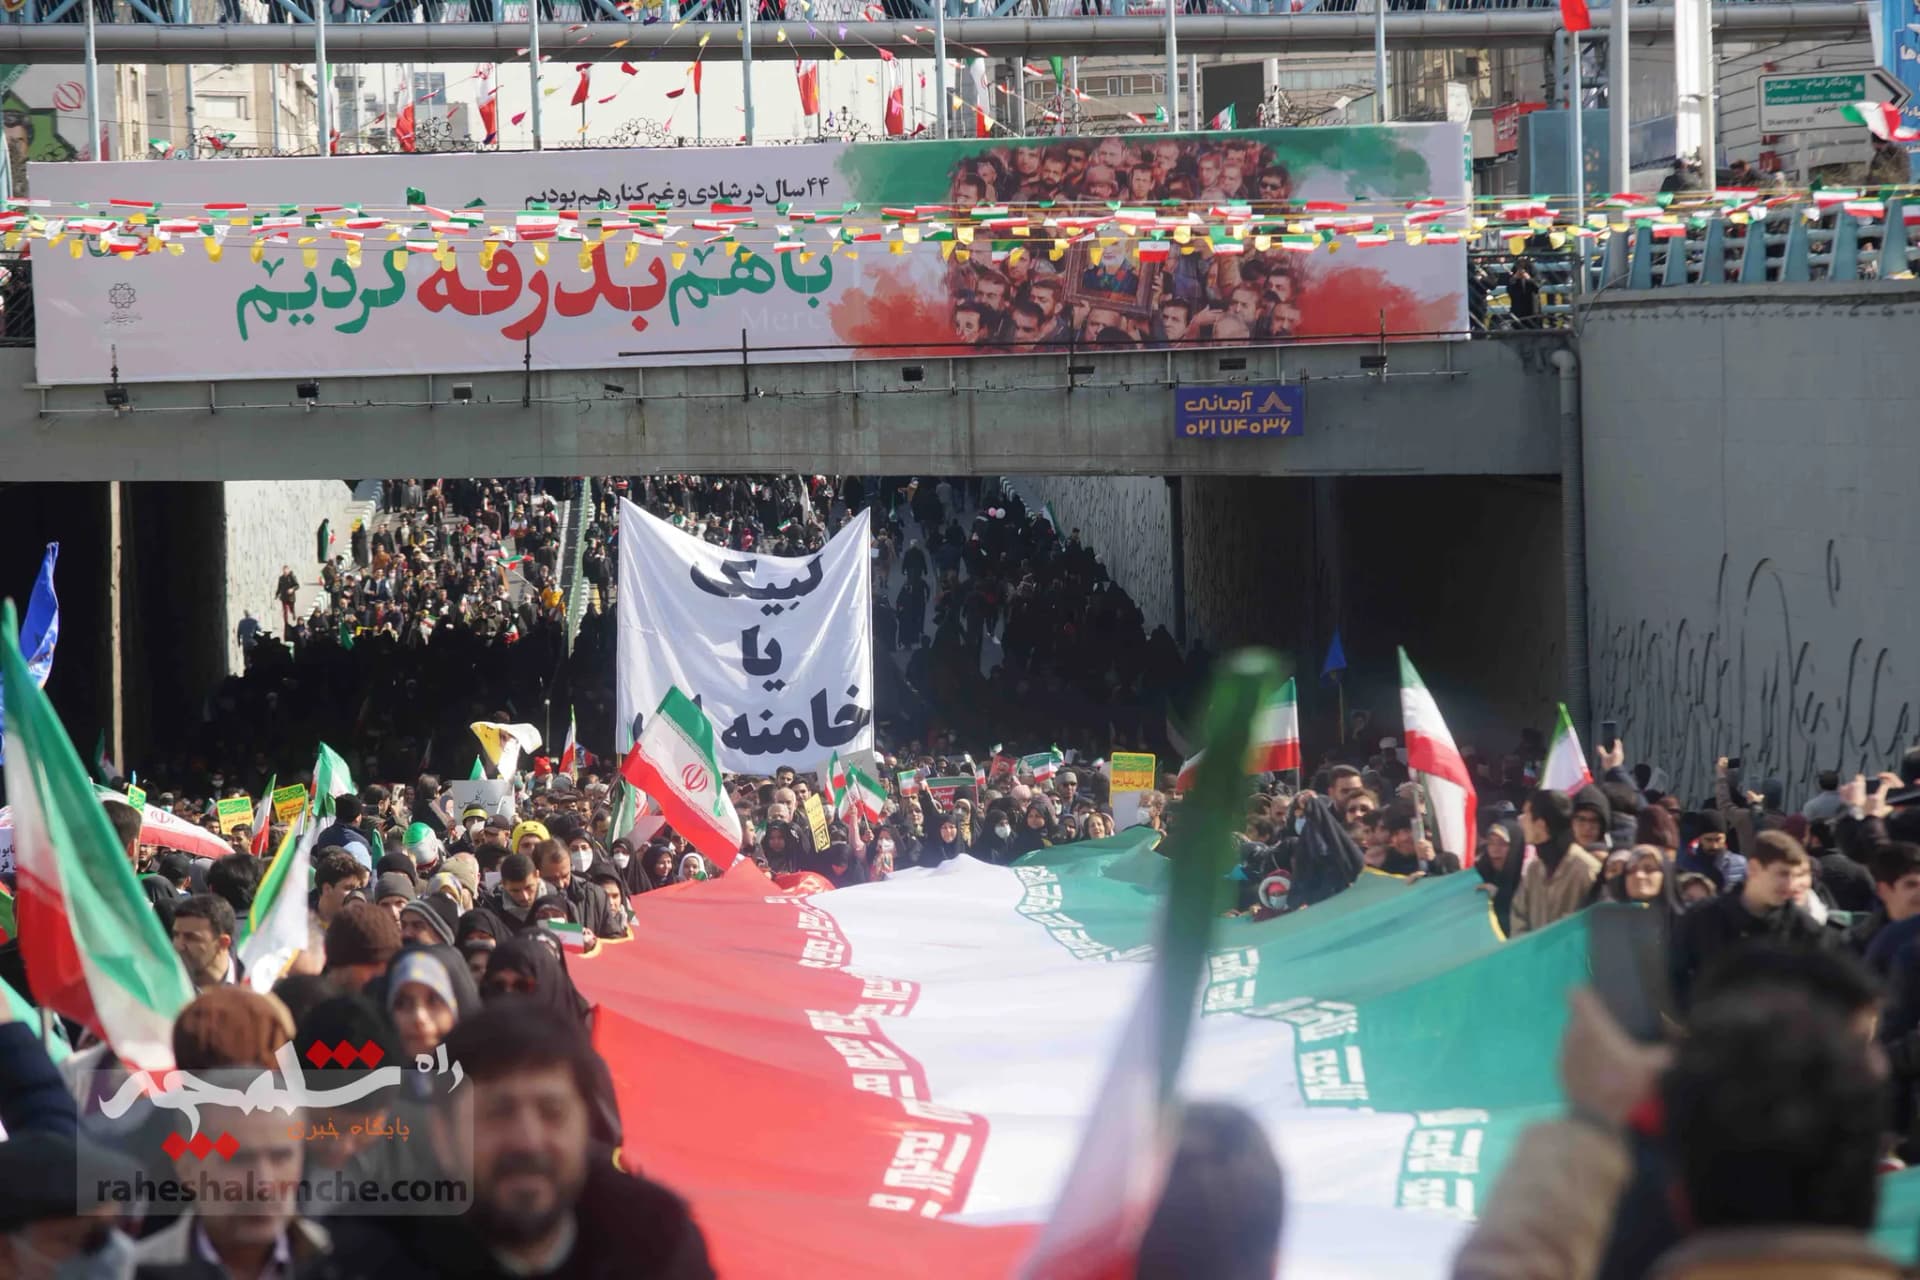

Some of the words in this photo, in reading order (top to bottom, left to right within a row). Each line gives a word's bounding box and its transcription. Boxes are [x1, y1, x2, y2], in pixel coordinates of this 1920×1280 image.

[578, 187, 612, 211] هم
[612, 183, 649, 207] کنار
[647, 181, 675, 206] غم
[676, 188, 688, 207] و
[688, 179, 742, 205] شادی
[743, 183, 765, 205] در
[765, 178, 806, 205] سال
[807, 176, 830, 198] ۴۴
[1184, 391, 1254, 413] آرمانی
[690, 554, 824, 617] لبیک
[741, 624, 784, 693] یا
[720, 684, 872, 756] خامنه
